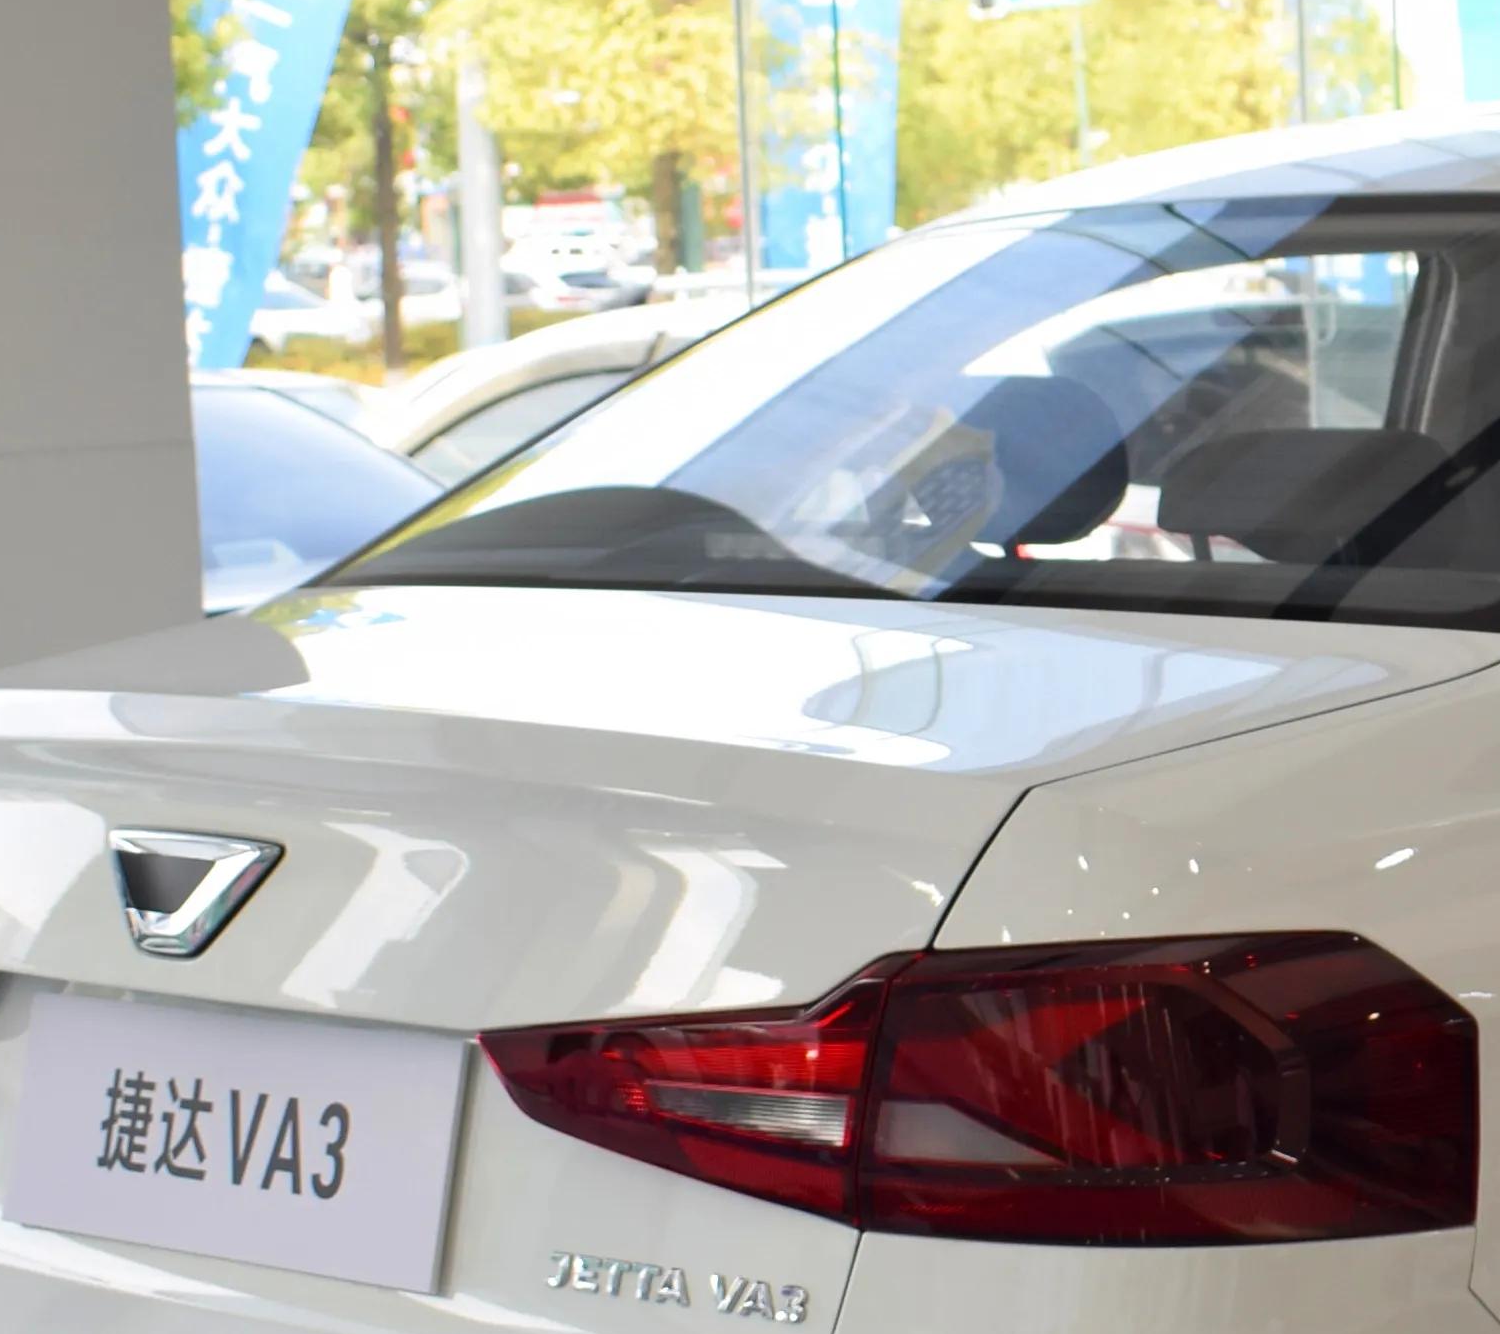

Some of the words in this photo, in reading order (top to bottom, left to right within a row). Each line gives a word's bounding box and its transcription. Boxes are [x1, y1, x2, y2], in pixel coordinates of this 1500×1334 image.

[97, 1067, 350, 1200] 捷达VA3
[547, 1249, 691, 1308] JETTA
[709, 1270, 809, 1324] VA3
